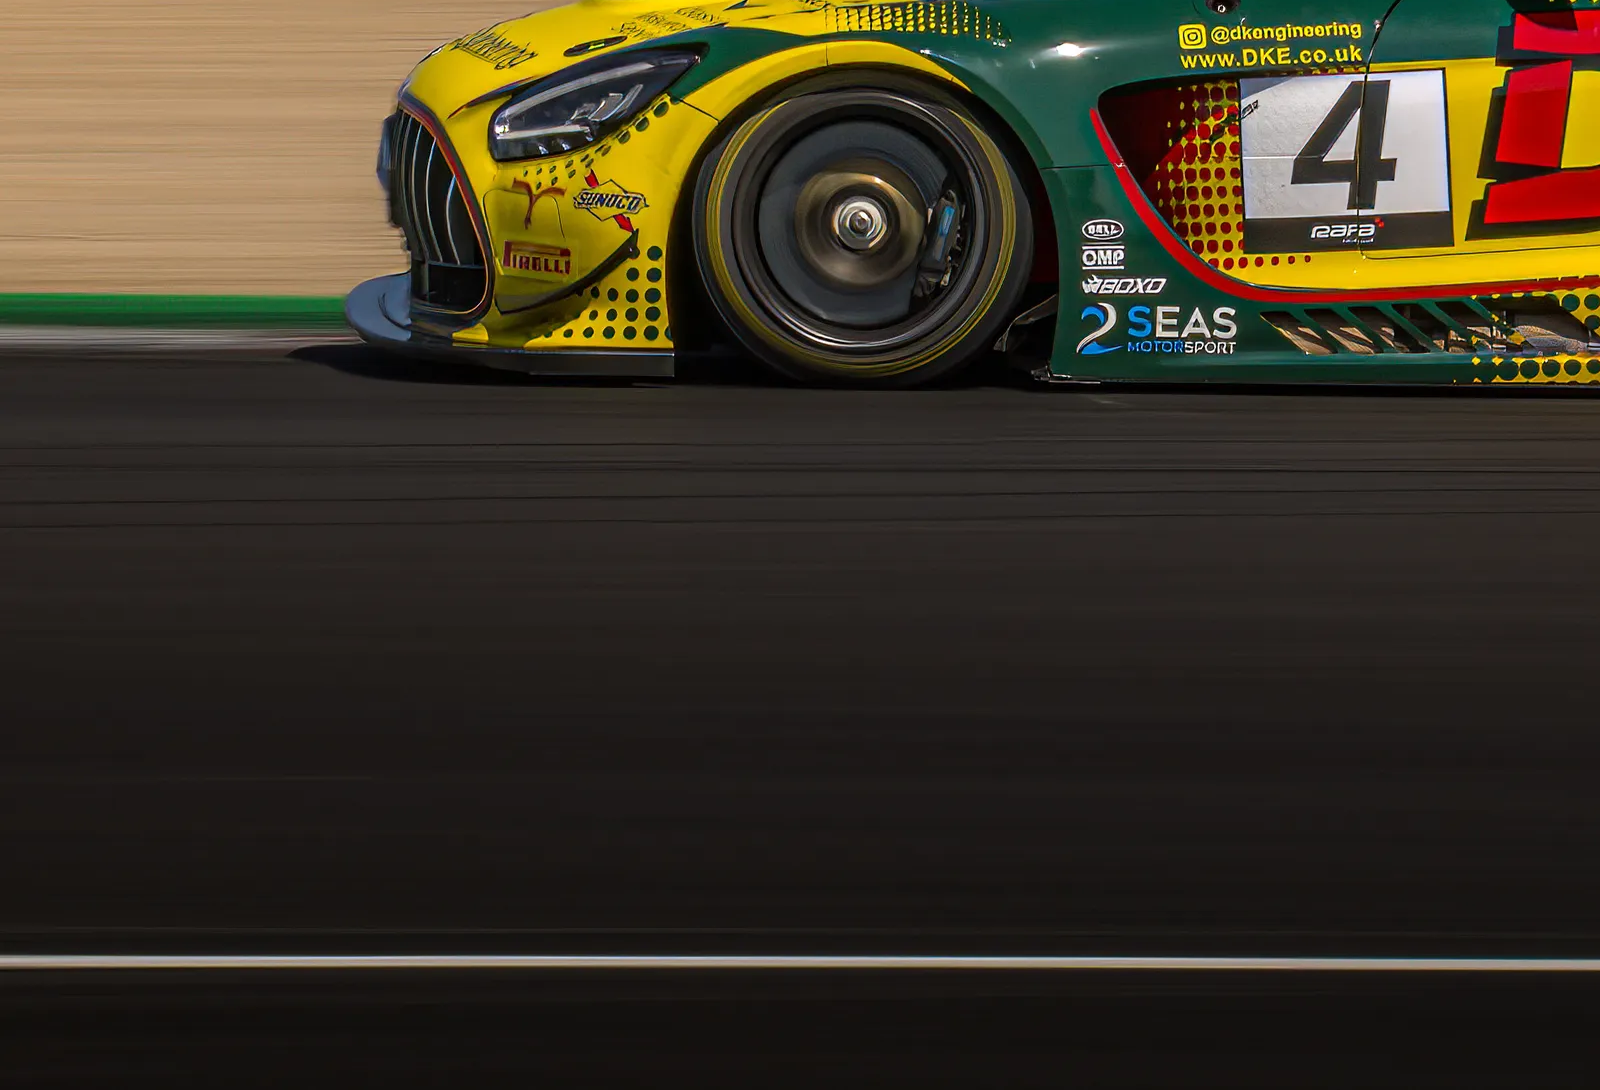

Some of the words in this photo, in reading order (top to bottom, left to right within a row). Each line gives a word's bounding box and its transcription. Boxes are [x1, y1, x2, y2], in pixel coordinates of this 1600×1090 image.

[1210, 22, 1362, 45] @dkengineering
[1180, 45, 1363, 69] www.DKE.co.uk
[1290, 79, 1398, 210] 4
[578, 191, 643, 211] SUNOCO
[503, 240, 571, 275] PIRELLI
[1082, 249, 1125, 266] OMP
[1127, 305, 1238, 339] SEAS
[1127, 341, 1237, 354] MOTORSPORT
